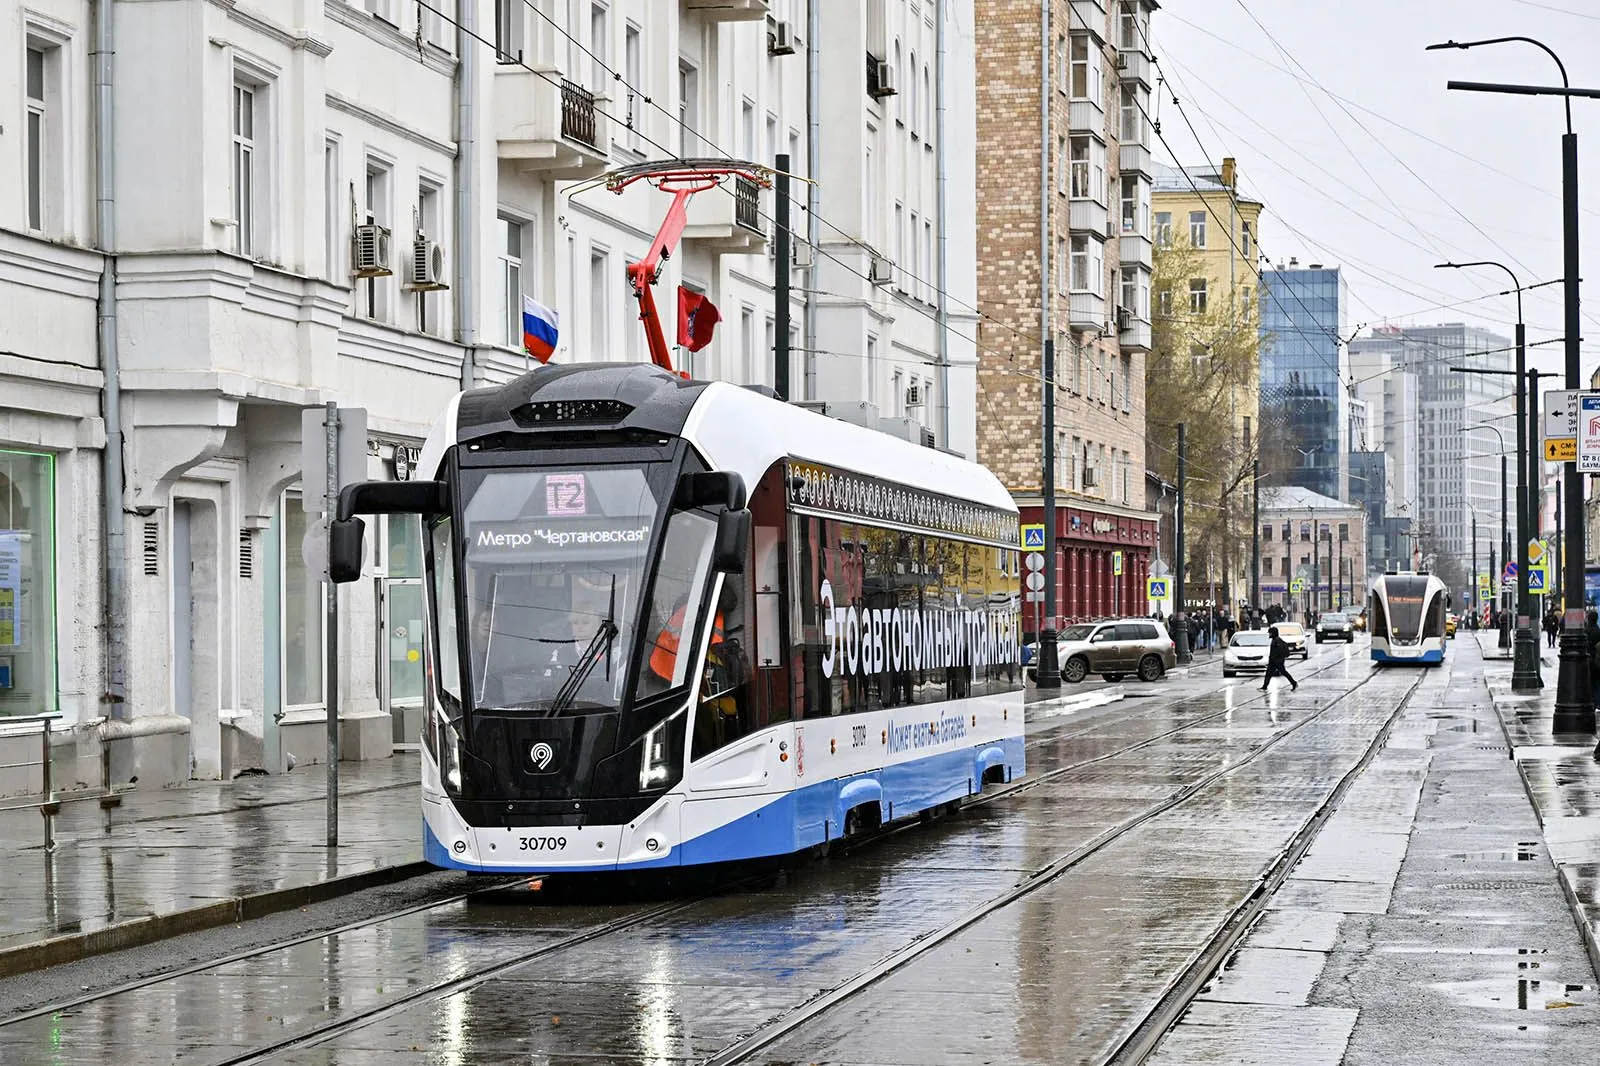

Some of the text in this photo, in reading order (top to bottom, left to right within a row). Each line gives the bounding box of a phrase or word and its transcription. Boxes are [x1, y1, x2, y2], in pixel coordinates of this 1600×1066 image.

[547, 482, 584, 509] Т2
[477, 526, 649, 548] Метро "Чертановская"
[820, 579, 859, 679] Это
[862, 589, 964, 676] автономный
[886, 719, 912, 755] Может
[519, 837, 567, 851] 30709
